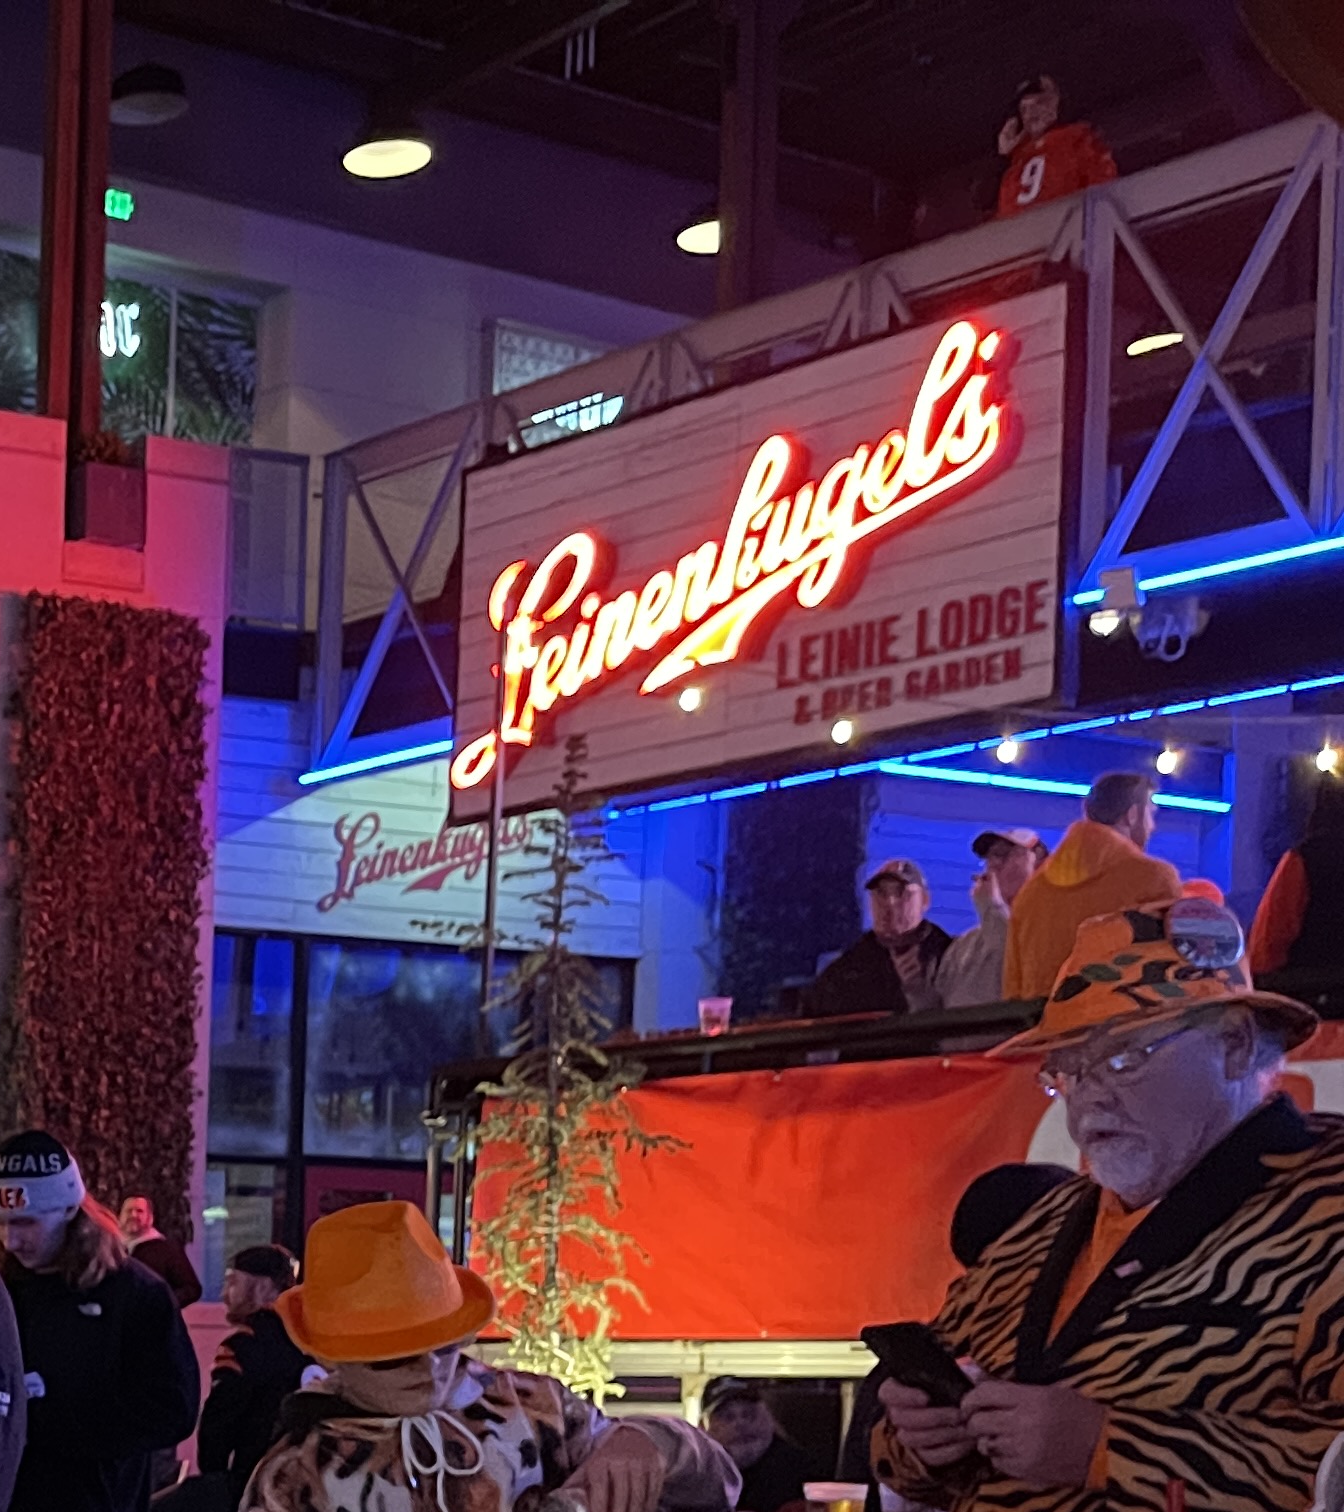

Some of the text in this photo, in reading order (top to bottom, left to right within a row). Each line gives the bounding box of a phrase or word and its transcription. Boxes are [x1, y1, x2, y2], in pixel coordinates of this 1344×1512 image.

[1017, 156, 1045, 205] 9
[451, 320, 1002, 789] Leinenkugel's
[776, 579, 1049, 688] LEINIE LODGE
[904, 648, 1022, 700] GARDEN
